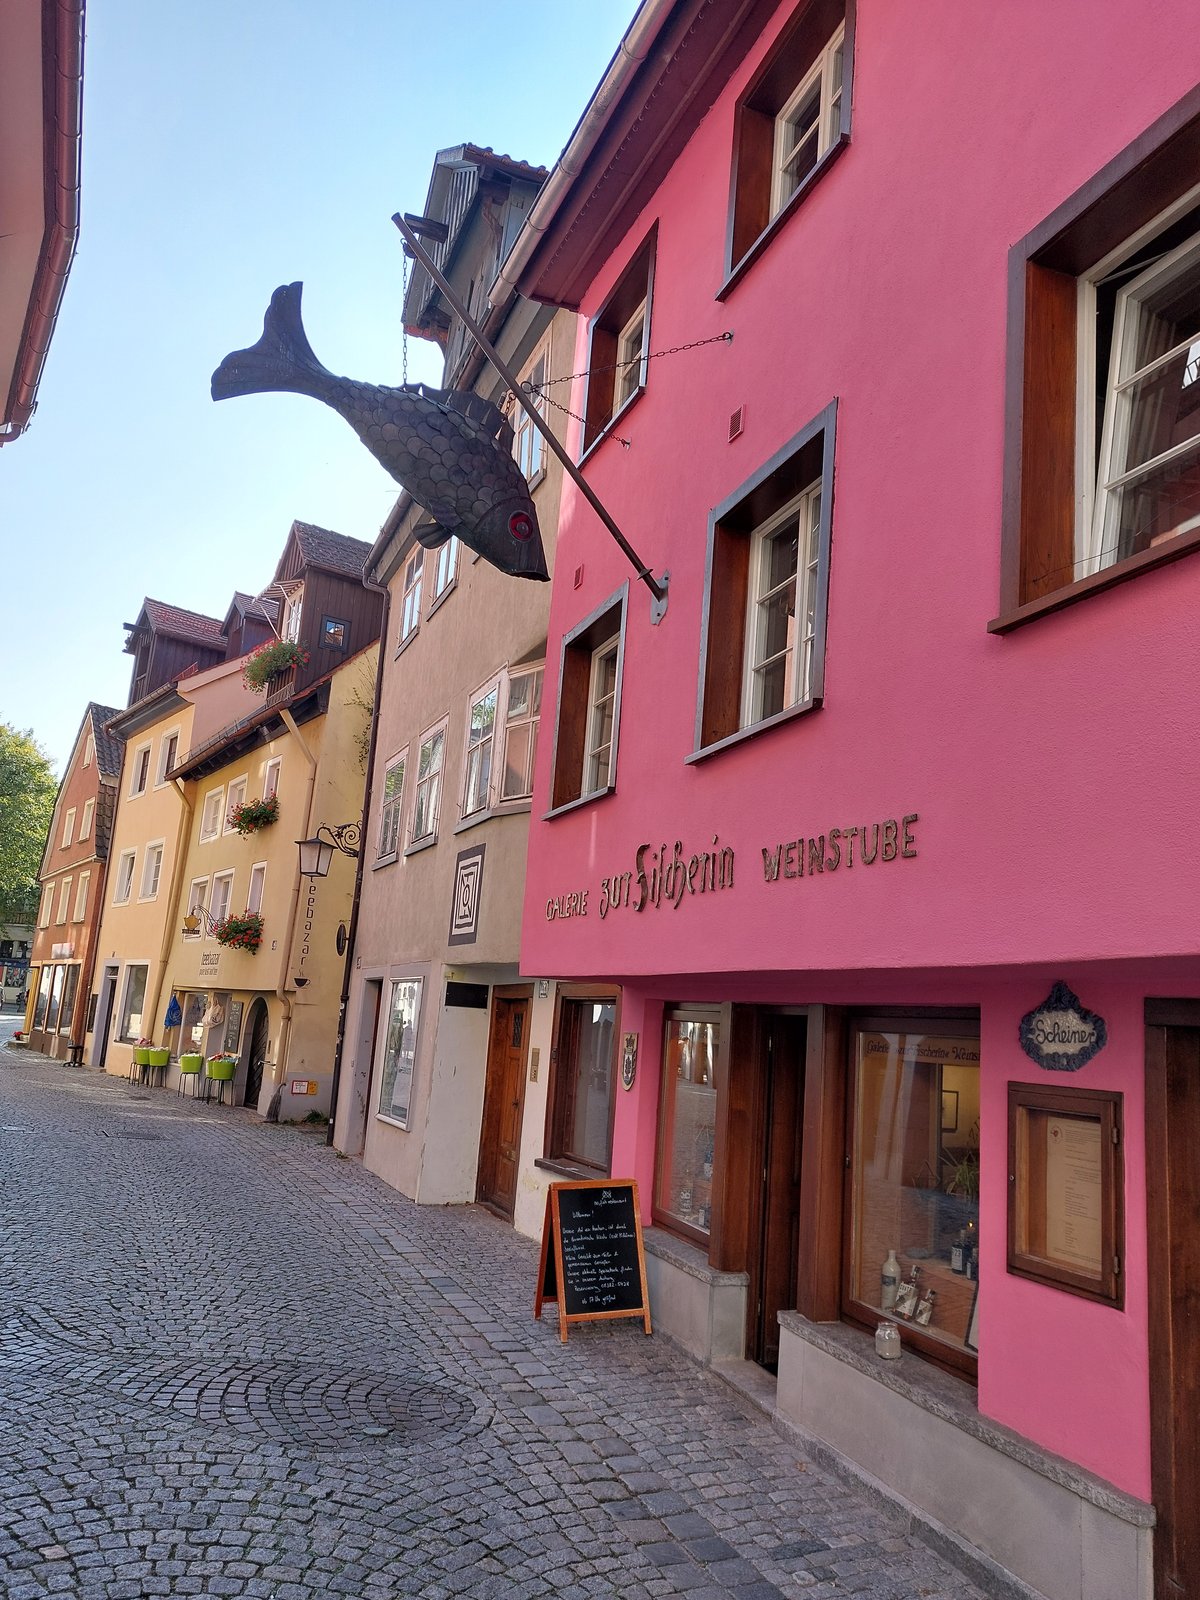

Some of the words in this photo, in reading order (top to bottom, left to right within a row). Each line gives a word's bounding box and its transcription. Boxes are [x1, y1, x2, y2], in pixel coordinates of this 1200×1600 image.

[545, 890, 589, 921] GALERIE
[599, 872, 633, 919] zur
[761, 813, 918, 882] WEINSTUBE
[1035, 1019, 1096, 1045] Scheiner
